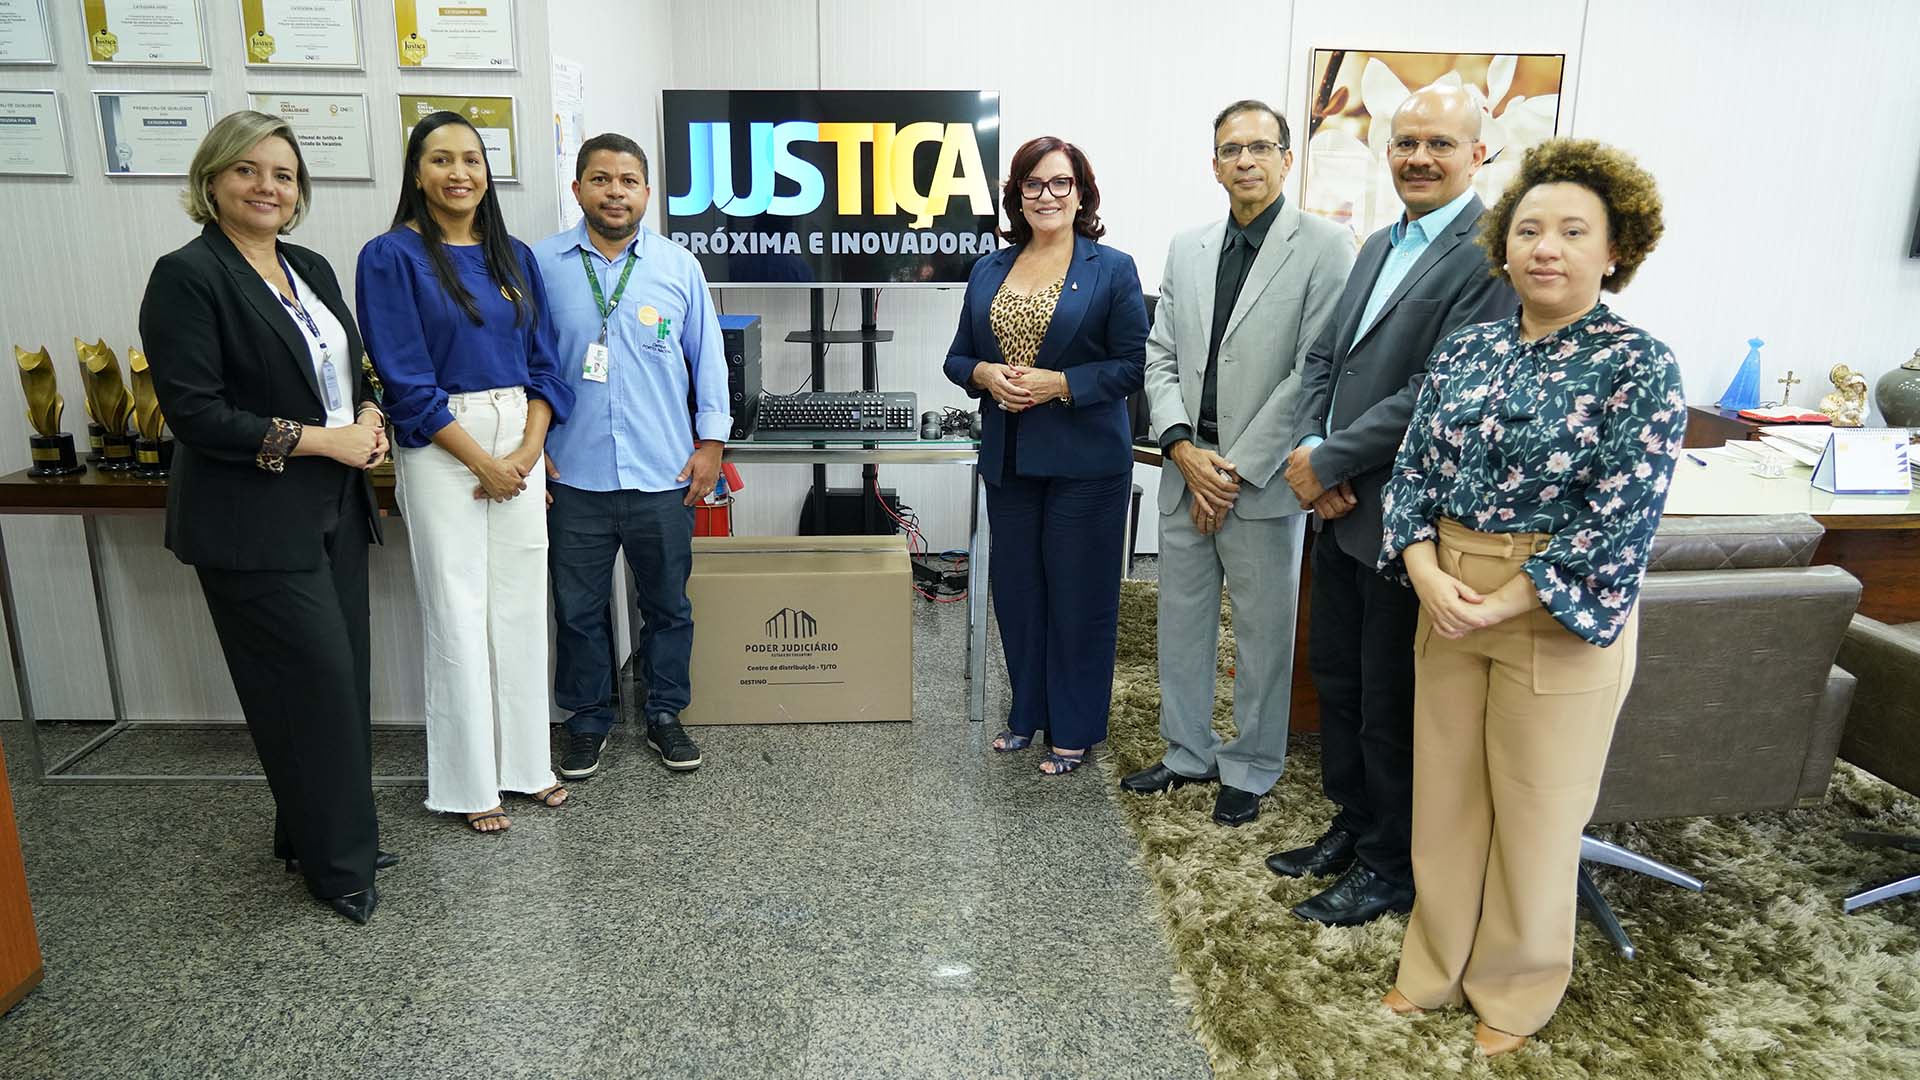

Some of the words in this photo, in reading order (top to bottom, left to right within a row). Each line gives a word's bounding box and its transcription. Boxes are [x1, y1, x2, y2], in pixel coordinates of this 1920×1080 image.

[668, 121, 995, 229] JUSTIÇA
[671, 226, 802, 254] PRÓXIMA
[809, 232, 823, 254] E
[831, 231, 996, 255] INOVADORA
[745, 644, 779, 653] PODER
[781, 641, 838, 652] JUDICIÁRIO
